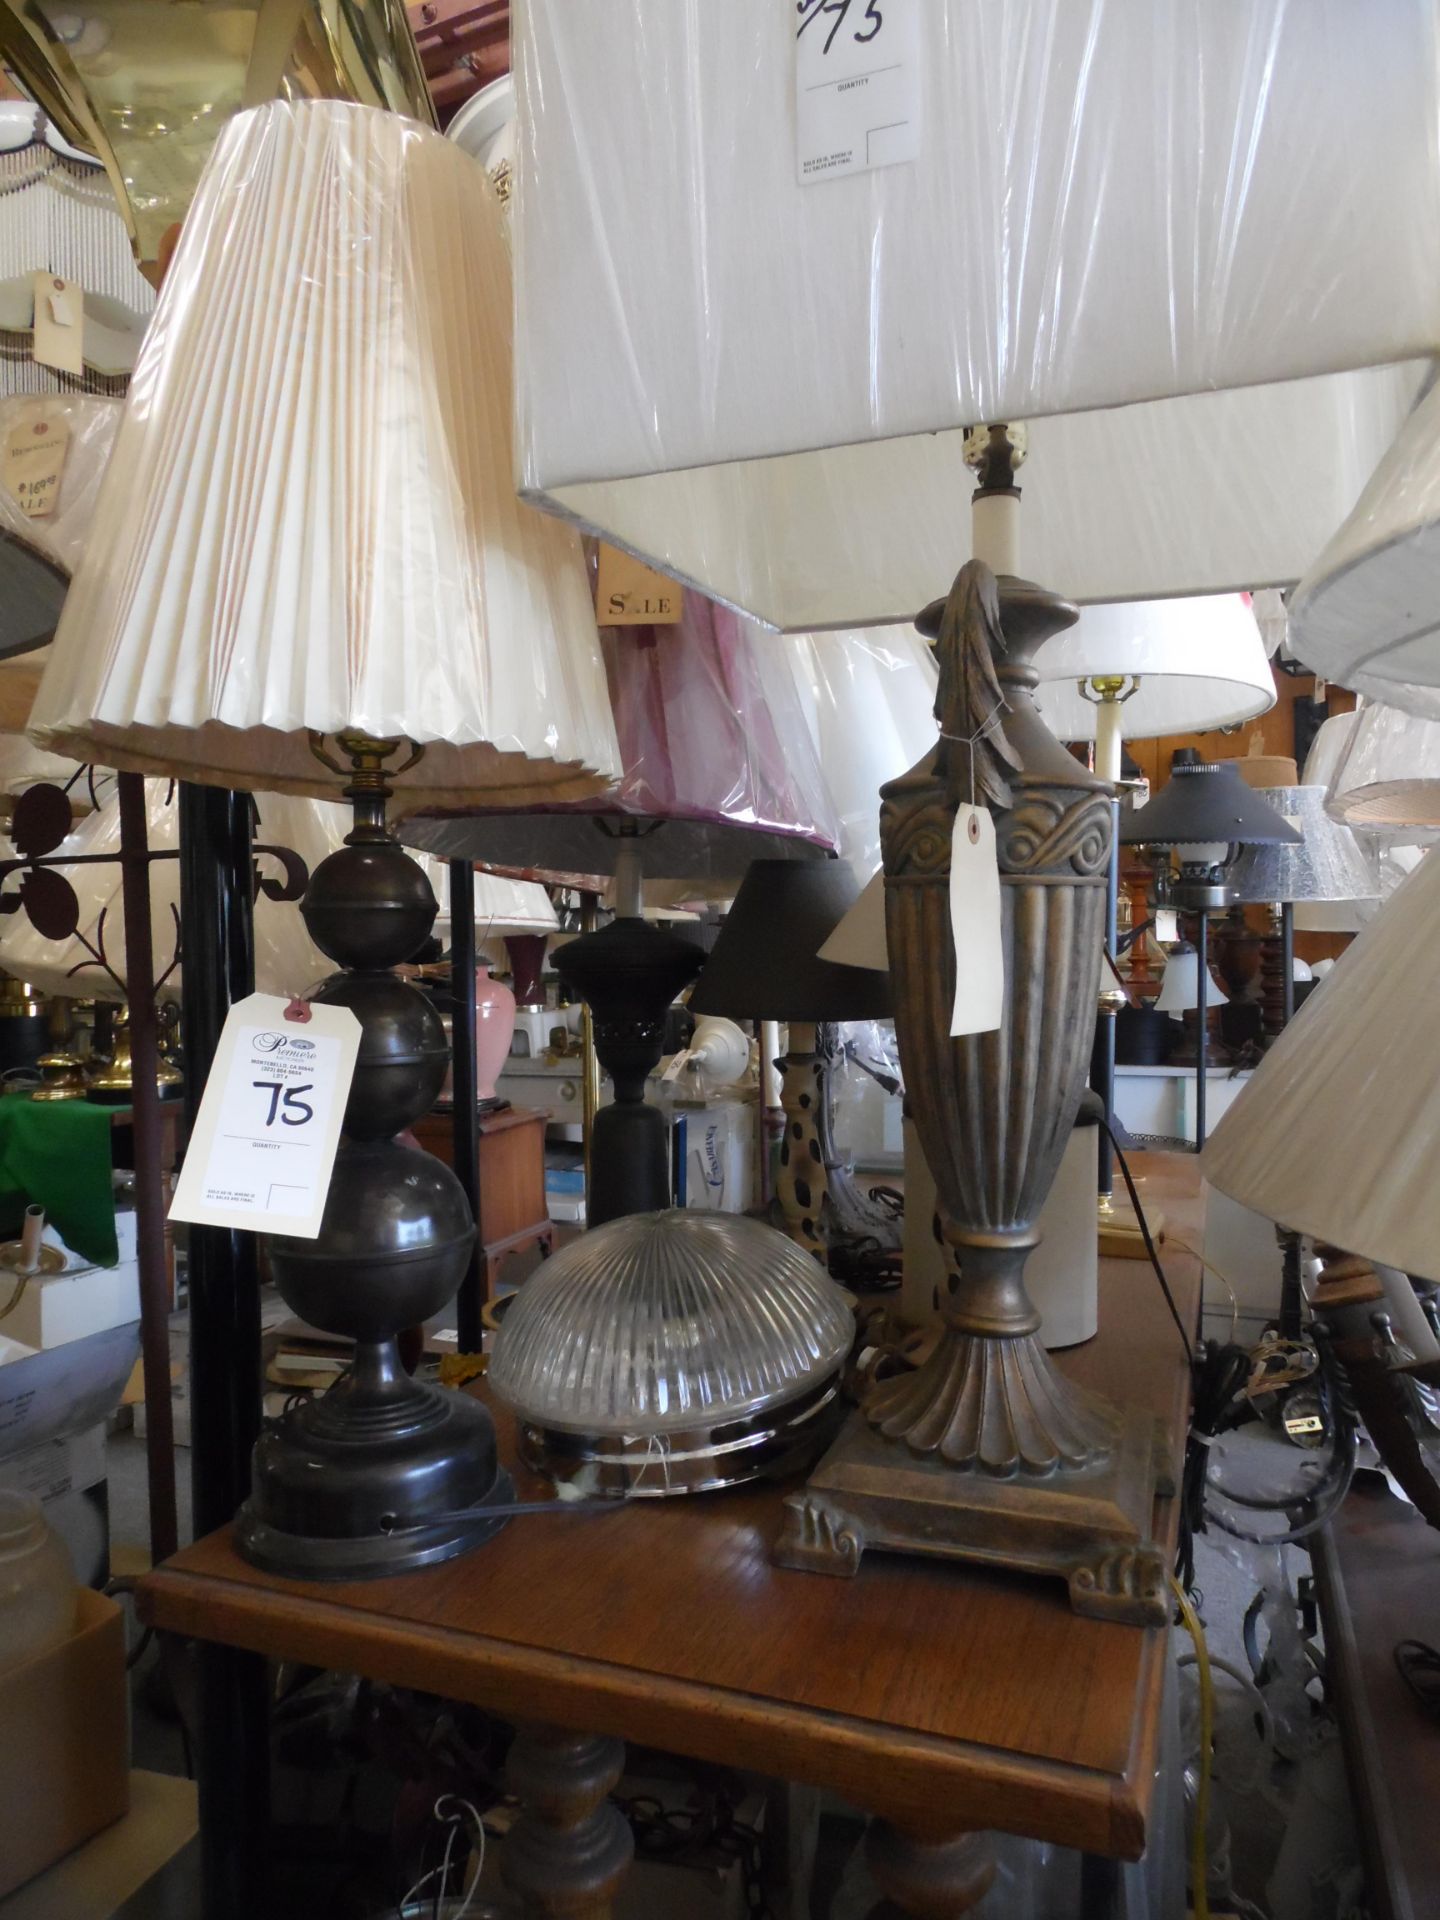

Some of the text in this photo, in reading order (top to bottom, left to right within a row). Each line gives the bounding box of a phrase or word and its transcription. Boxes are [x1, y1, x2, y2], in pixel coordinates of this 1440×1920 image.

[837, 78, 869, 92] QUANTITY
[252, 1032, 317, 1059] Premiere
[253, 1081, 314, 1127] 75
[252, 1141, 281, 1150] QUANTITY
